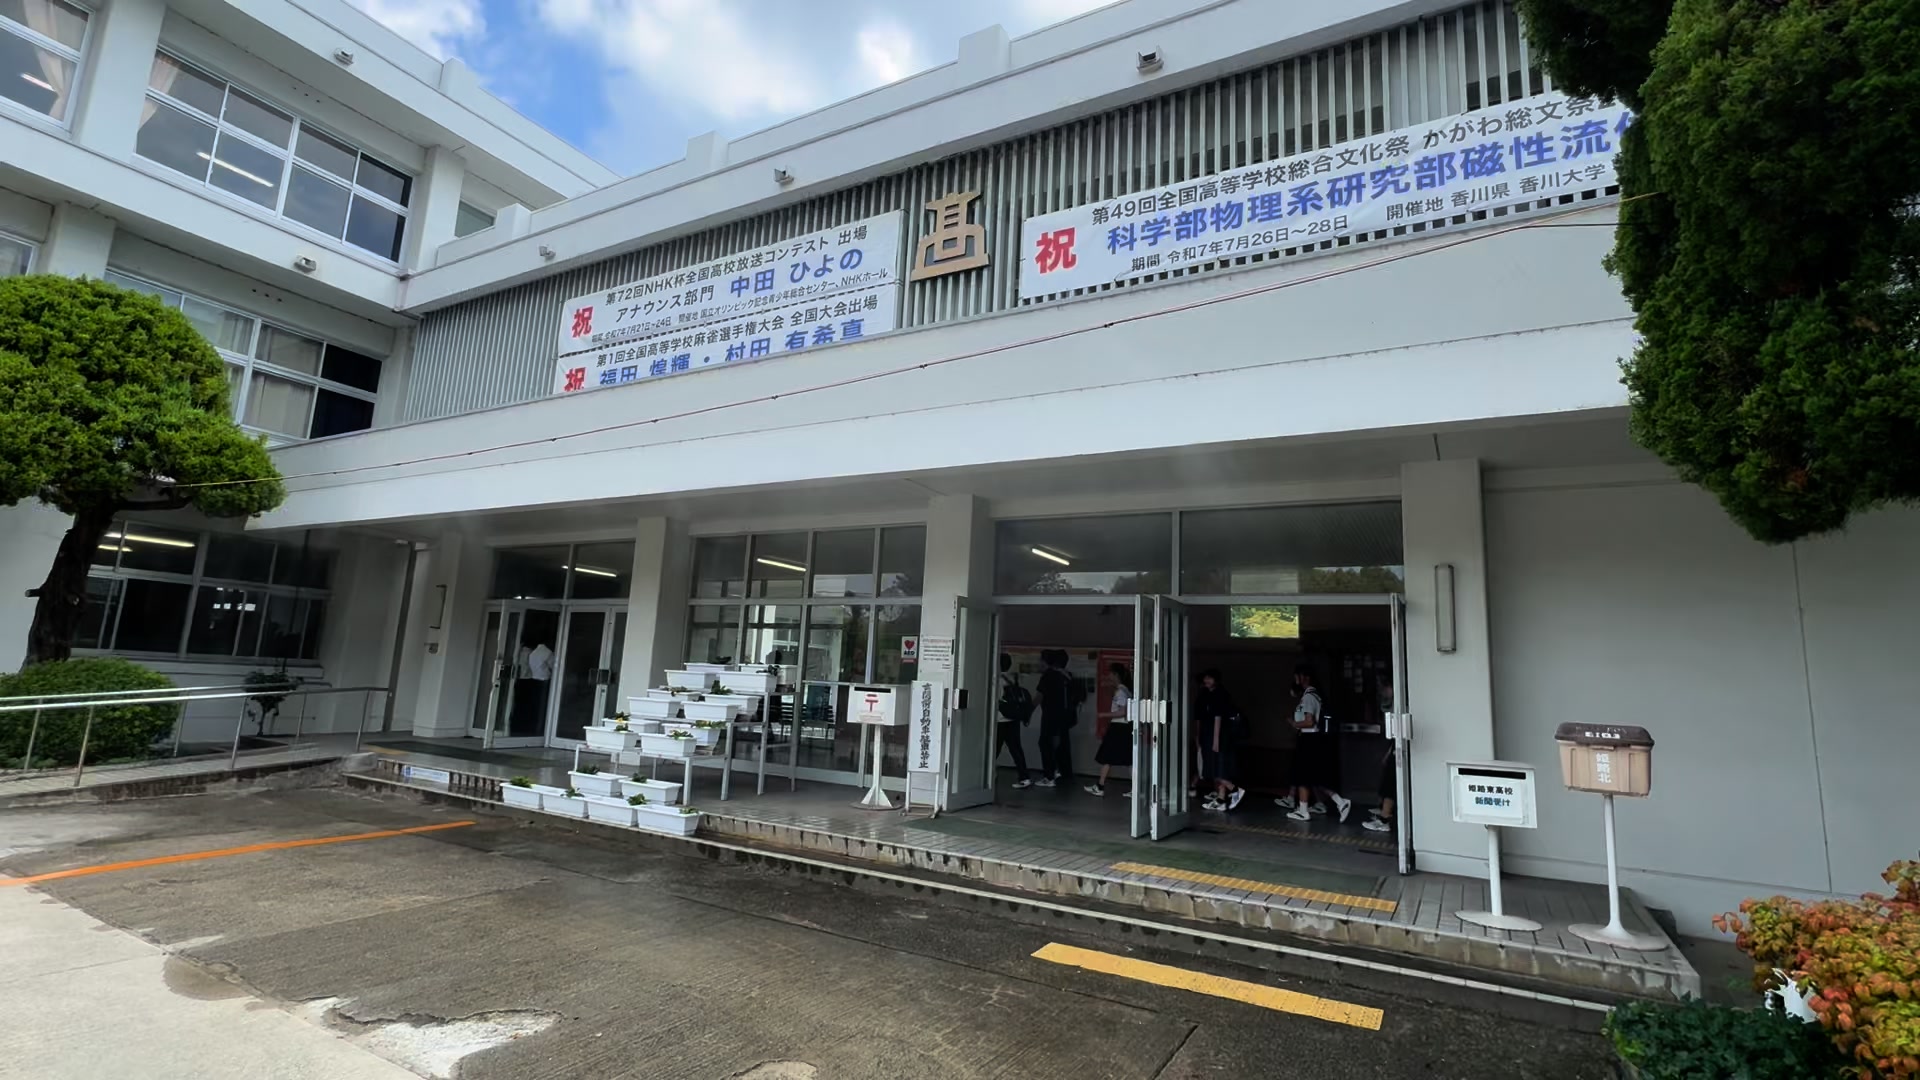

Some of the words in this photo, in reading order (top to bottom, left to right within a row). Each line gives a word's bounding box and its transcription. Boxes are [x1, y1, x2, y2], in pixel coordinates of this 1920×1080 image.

[1092, 135, 1410, 226] 第49回全国高等学校総合文化祭
[1423, 97, 1616, 149] かがわ総文祭
[1035, 227, 1077, 274] 祝
[1131, 254, 1160, 272] 期間
[1386, 196, 1444, 221] 開催地
[1451, 182, 1510, 208] 香川県
[1520, 163, 1606, 193] 香川大学
[605, 236, 829, 306] 第72回NHK杯全国高校放送コンテスト
[837, 225, 868, 247] 出場
[616, 285, 714, 323] アナウンス部門
[730, 269, 775, 298] 中田
[790, 249, 863, 284] ひよの
[572, 306, 594, 338] 祝
[597, 315, 784, 367] 第1回全国高等学校麻雀選手権大会
[790, 294, 878, 326] 全国大会出場
[563, 366, 586, 392] 祝
[600, 365, 638, 385] 福田
[725, 337, 771, 362] 村田
